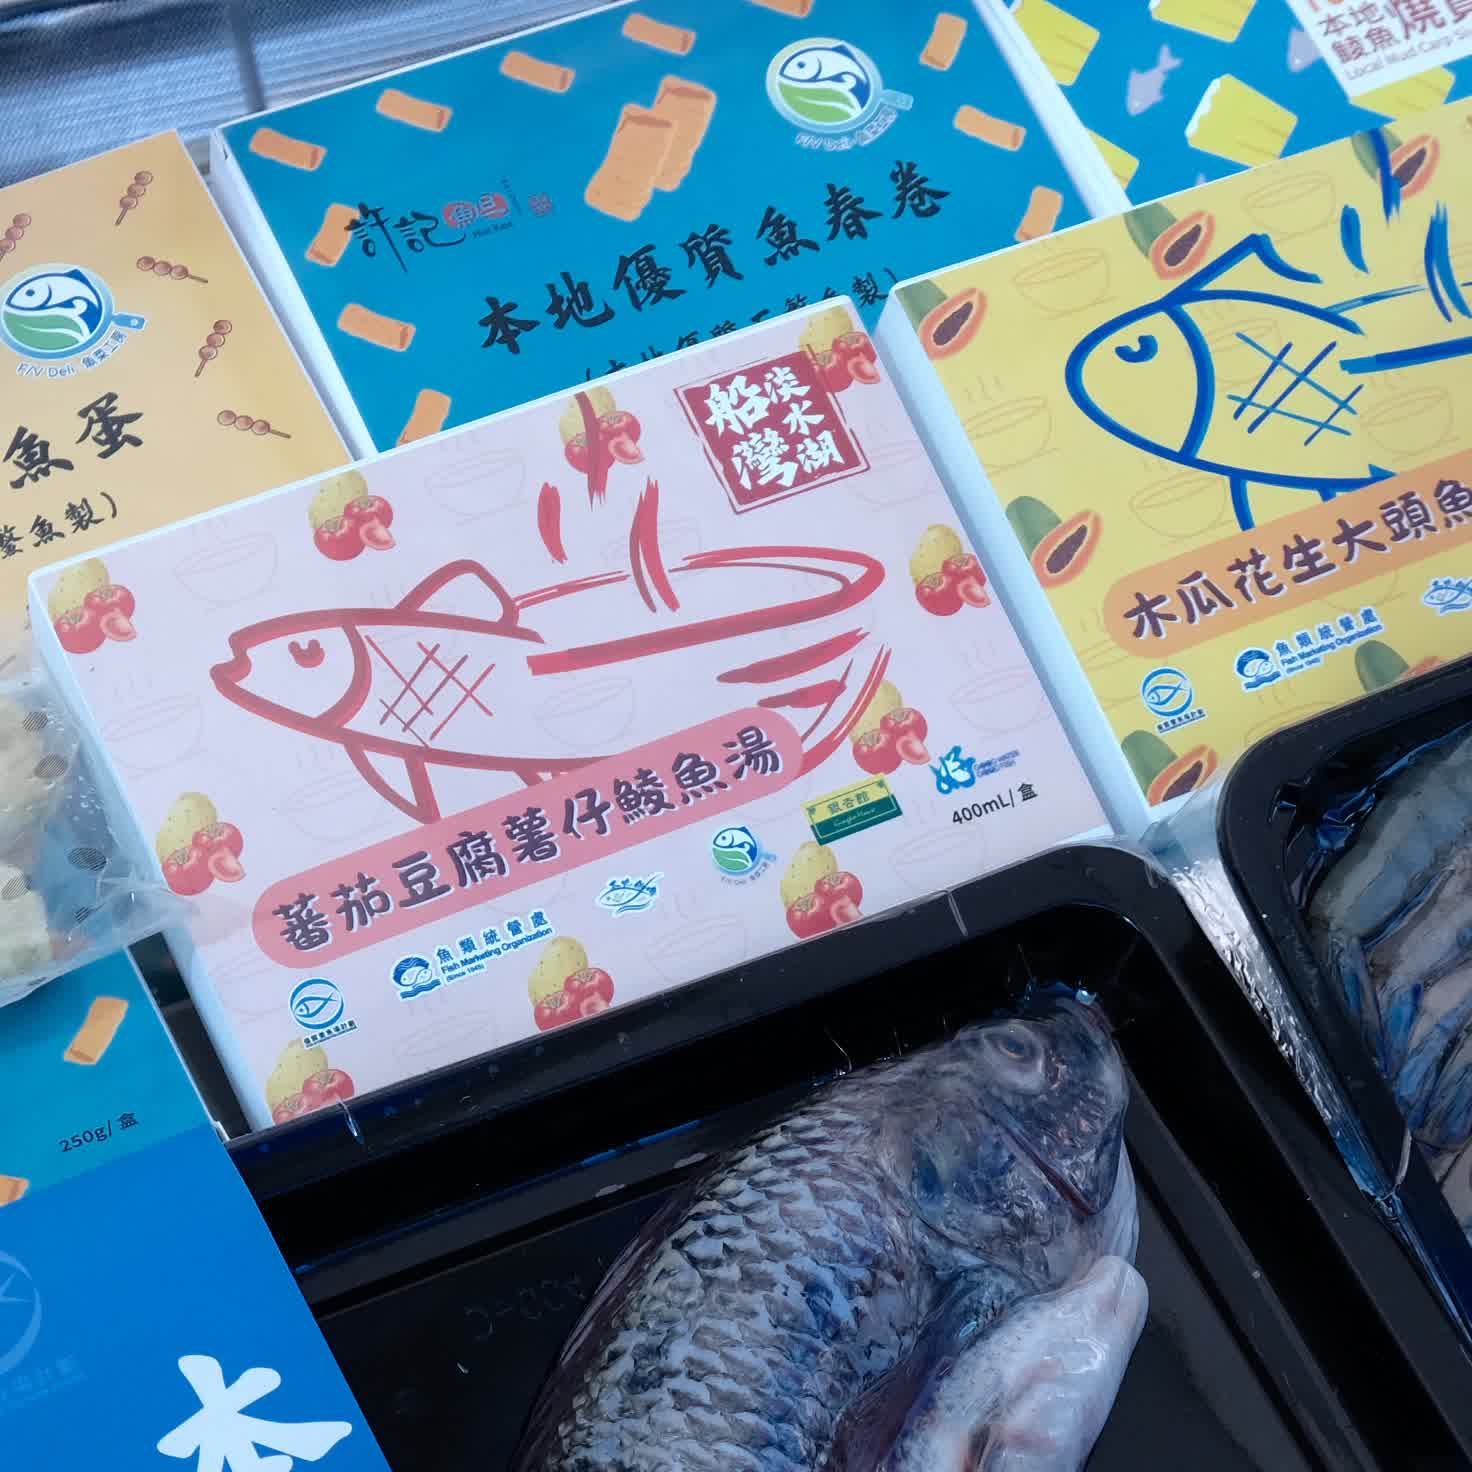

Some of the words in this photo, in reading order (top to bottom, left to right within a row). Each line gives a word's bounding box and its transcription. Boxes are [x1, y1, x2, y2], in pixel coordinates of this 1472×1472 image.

[1319, 2, 1384, 37] 本地
[479, 160, 951, 355] 本地優質魚春卷
[704, 375, 799, 491] 船灣
[764, 366, 845, 474] 淡水湖
[951, 788, 1016, 826] 400mL/
[272, 726, 783, 951] 蕃茄豆腐薯仔鯪魚湯
[435, 910, 550, 964] 魚類統營處
[441, 959, 460, 976] Fish
[460, 943, 503, 968] Marketing
[501, 926, 554, 954] Organization
[58, 1121, 112, 1153] 250g/
